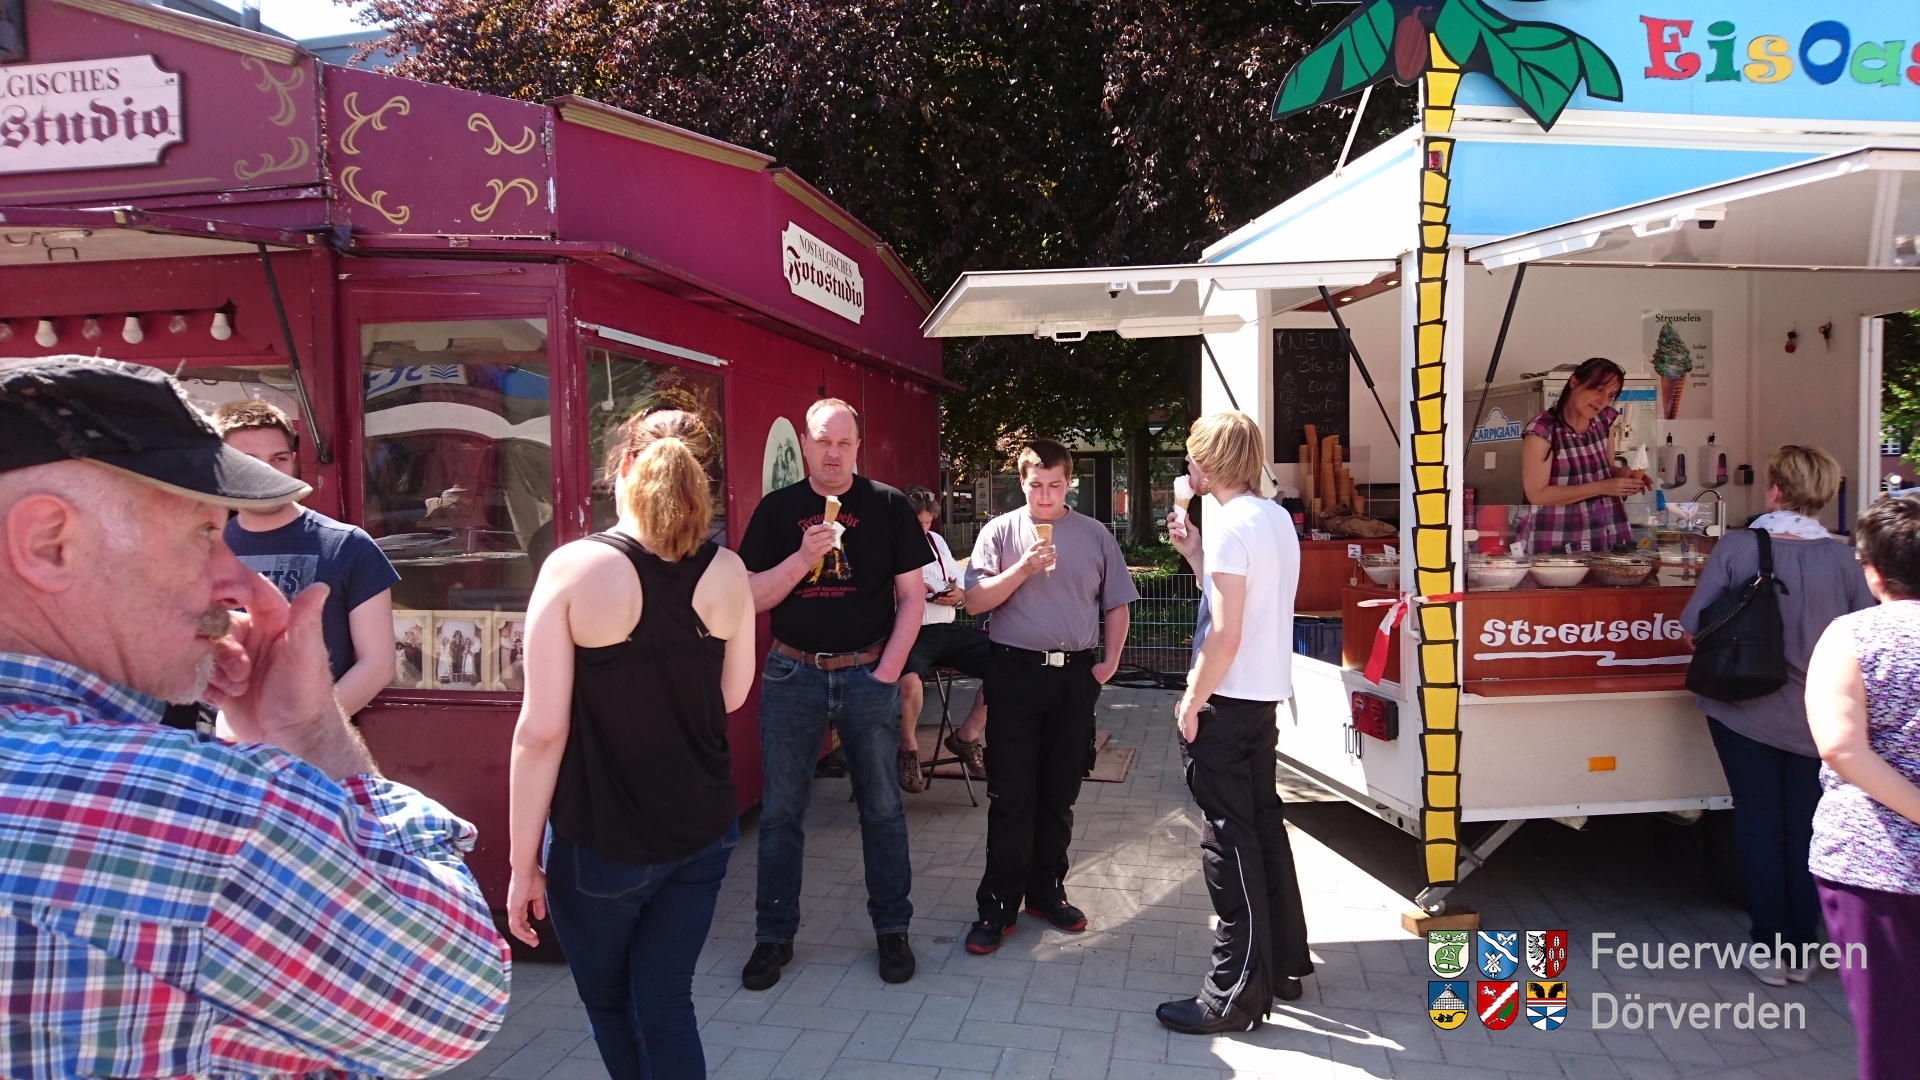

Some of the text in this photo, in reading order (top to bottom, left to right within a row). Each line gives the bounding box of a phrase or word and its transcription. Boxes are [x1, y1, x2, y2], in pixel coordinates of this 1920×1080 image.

[799, 233, 853, 278] NOSTALGISCHES
[787, 245, 862, 307] Fotostudio
[1655, 313, 1701, 324] Streuseleis
[1296, 355, 1323, 373] Bis
[1307, 377, 1340, 393] zwei
[1299, 397, 1346, 413] Sorten
[1473, 425, 1520, 440] CARPIGIANI
[1479, 612, 1686, 647] Streusele
[1342, 722, 1362, 759] 100
